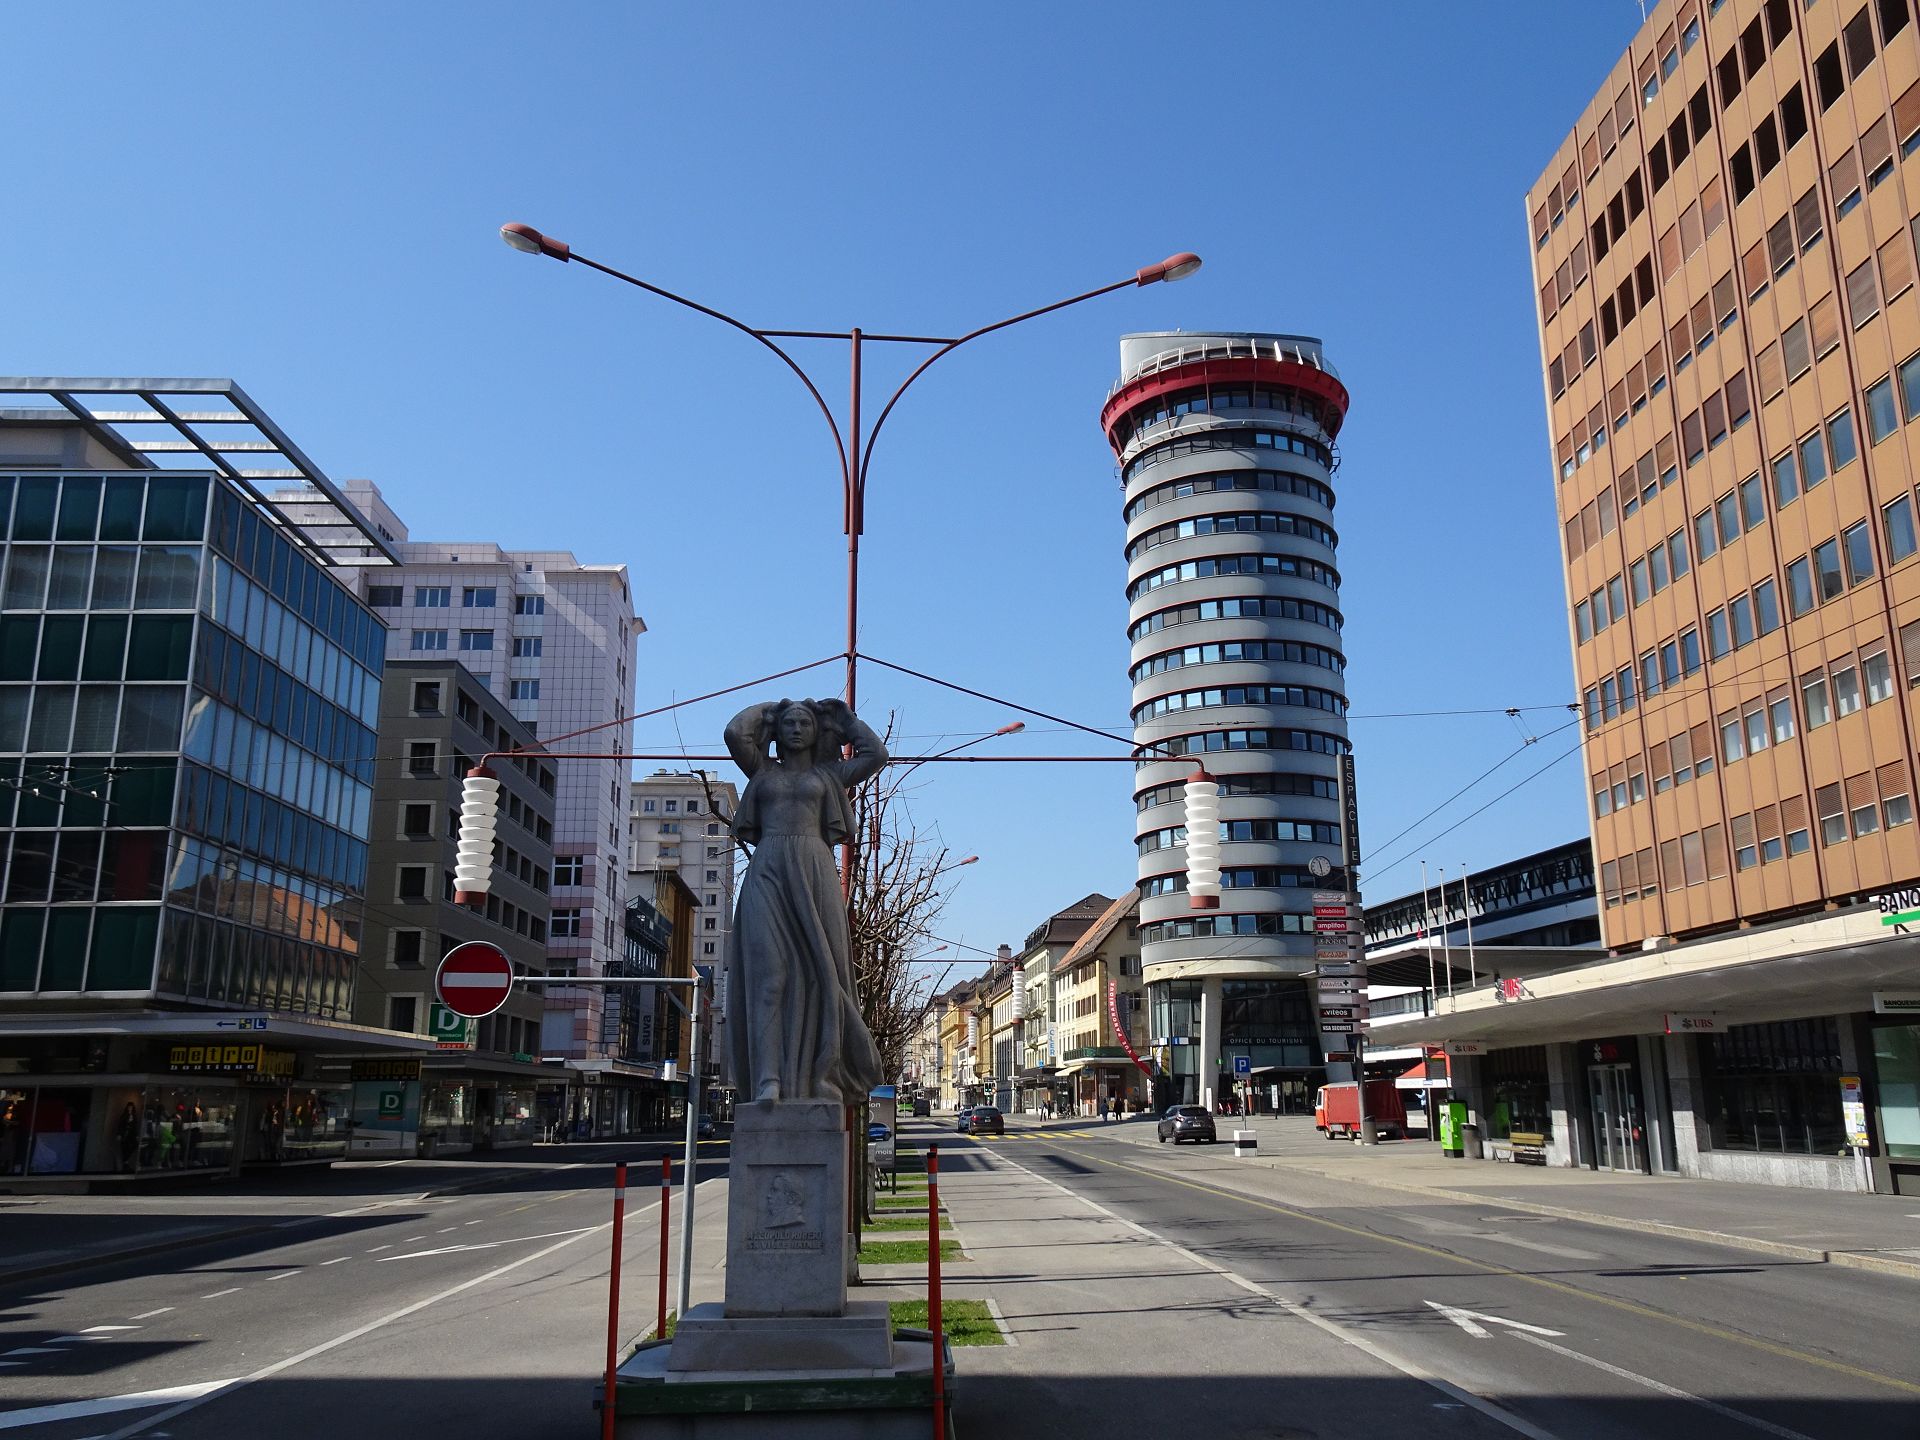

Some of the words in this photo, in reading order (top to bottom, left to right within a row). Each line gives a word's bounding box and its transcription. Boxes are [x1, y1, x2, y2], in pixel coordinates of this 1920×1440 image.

[1317, 922, 1345, 930] amplifon
[1109, 982, 1123, 1038] PANORAMIQUE
[438, 1009, 460, 1031] D
[1692, 1018, 1713, 1028] UBS
[643, 1014, 652, 1046] suva
[170, 1046, 257, 1064] metro
[1239, 1059, 1247, 1071] P
[385, 1094, 400, 1109] D
